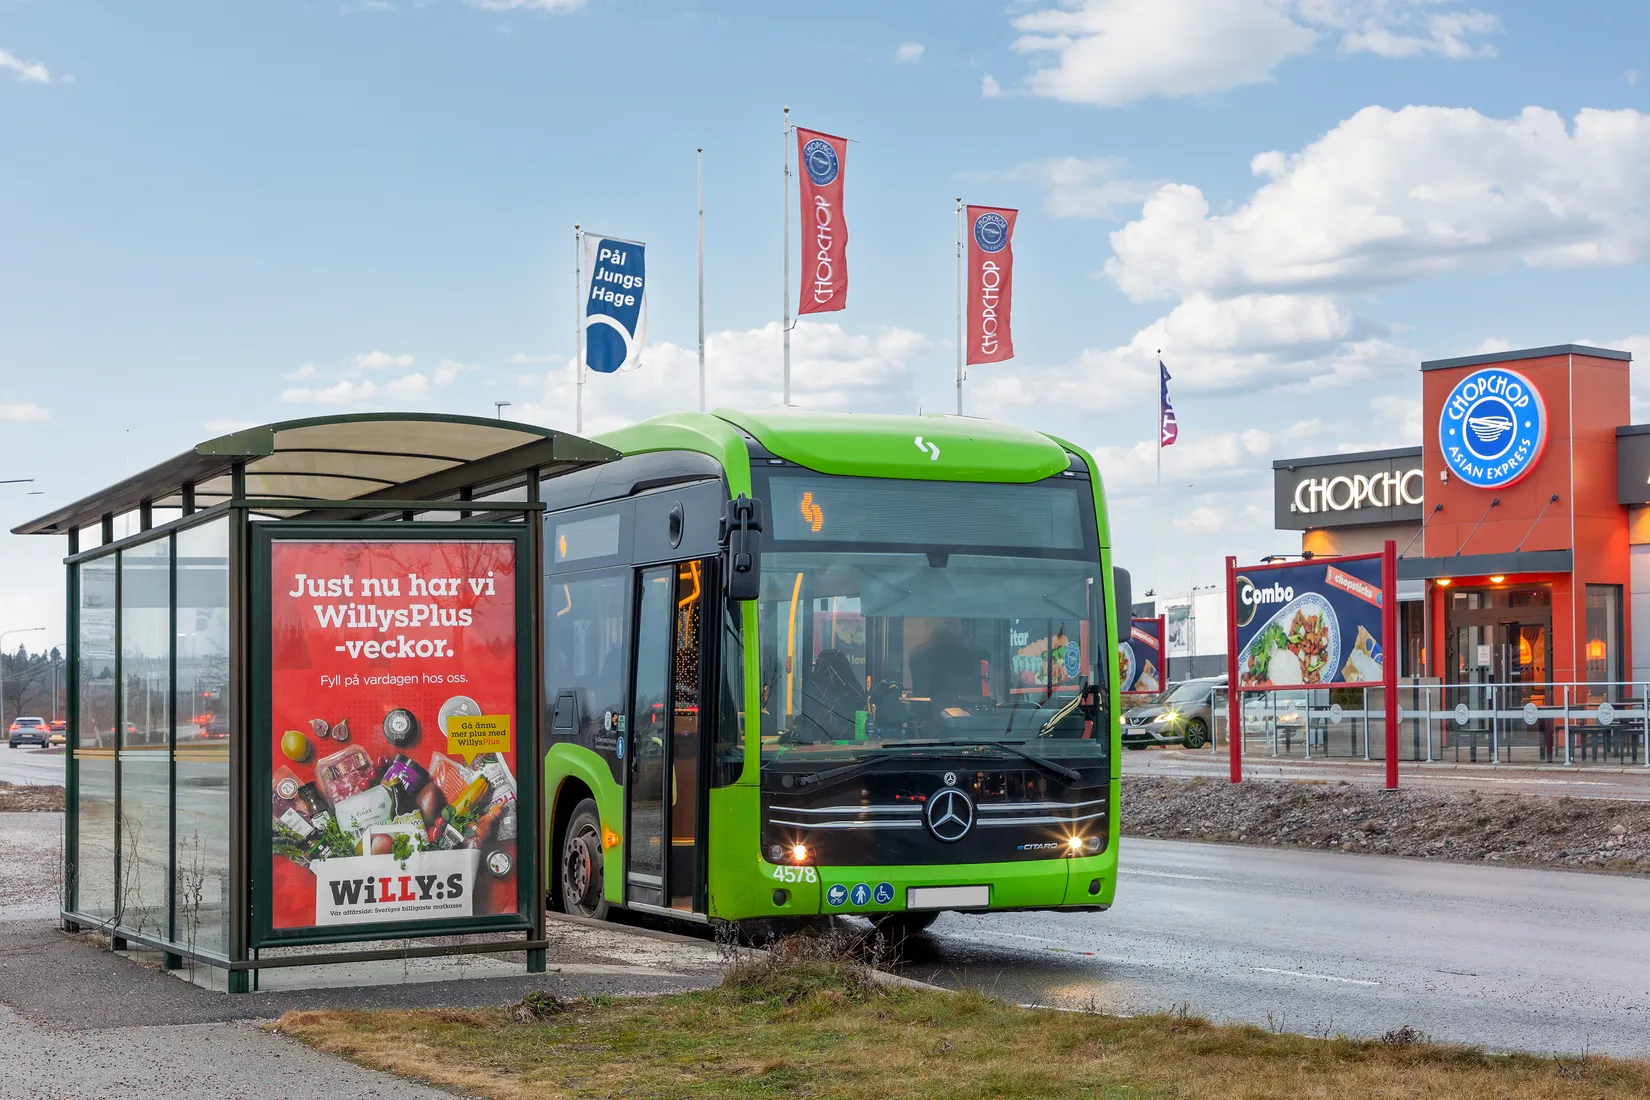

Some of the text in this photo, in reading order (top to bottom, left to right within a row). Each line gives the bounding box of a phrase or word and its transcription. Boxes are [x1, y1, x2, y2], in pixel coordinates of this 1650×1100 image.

[599, 248, 627, 266] Pål
[814, 195, 833, 303] CHOPCHOP
[596, 267, 643, 289] Jungs
[591, 286, 635, 307] Hage
[982, 260, 1000, 355] CHOPCHOP
[1448, 375, 1529, 420] CHOPCHOP
[1449, 438, 1531, 479] ASIAN EXPRESS
[1295, 469, 1424, 513] CHOPCHO
[288, 571, 496, 598] Just nu har vi
[1241, 582, 1294, 605] Combo
[1334, 574, 1373, 599] chopsticks
[313, 602, 473, 633] WillysPlus
[335, 635, 454, 659] -veckor.
[320, 672, 469, 688] Fyll på vardagen hos oss.
[458, 739, 500, 747] WillysPlus
[1017, 842, 1058, 850] eCITARO
[773, 865, 817, 884] 4578
